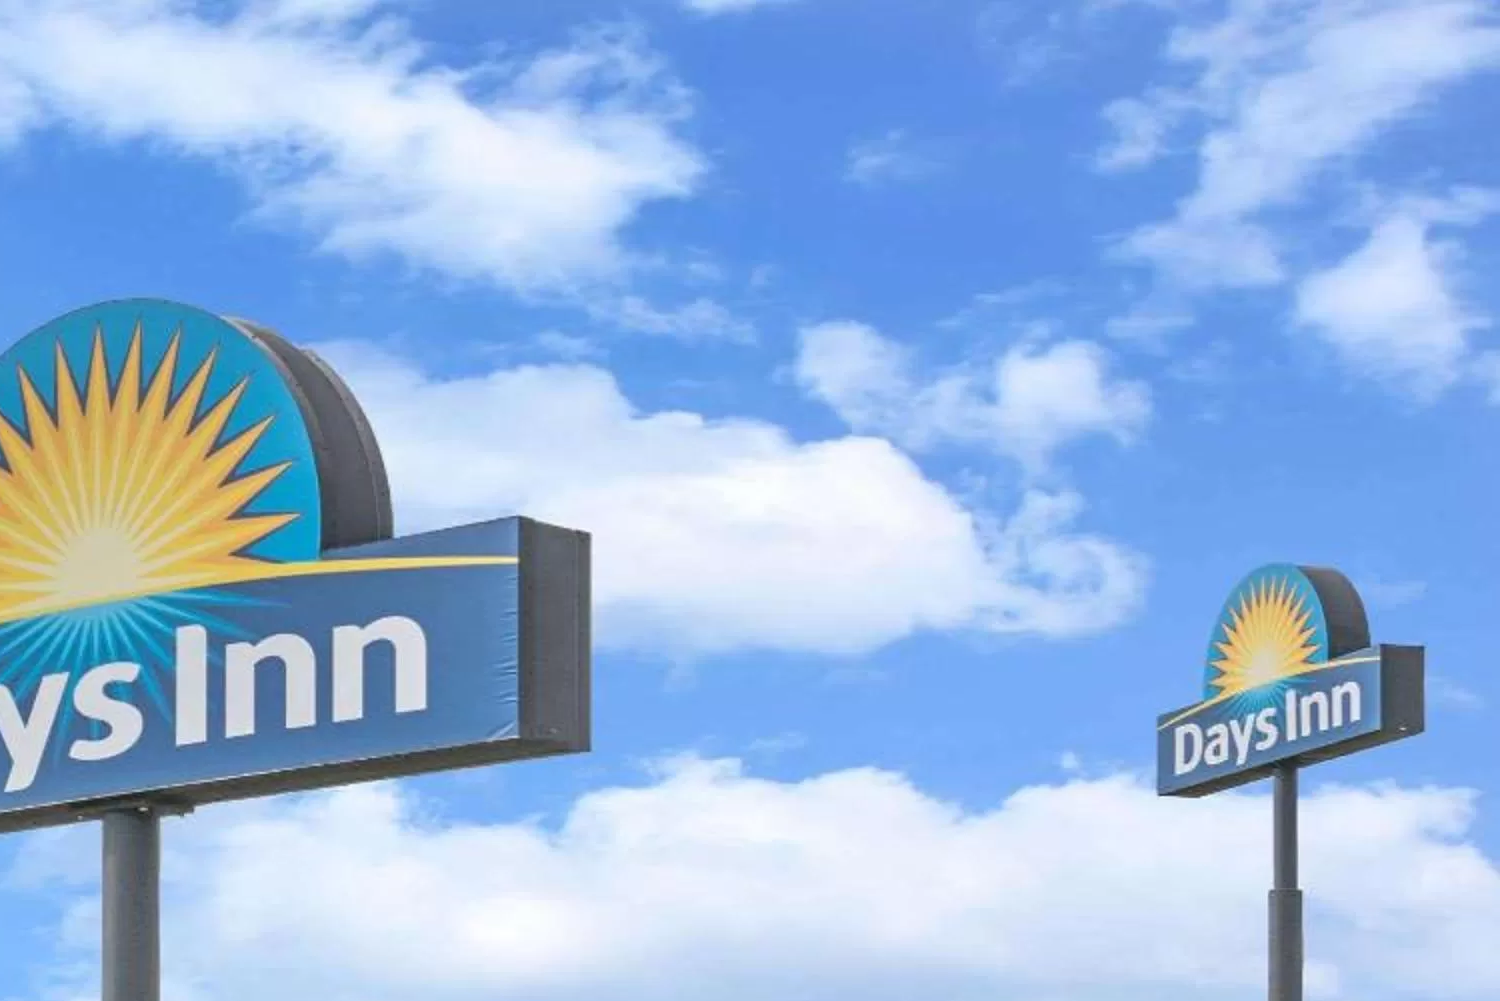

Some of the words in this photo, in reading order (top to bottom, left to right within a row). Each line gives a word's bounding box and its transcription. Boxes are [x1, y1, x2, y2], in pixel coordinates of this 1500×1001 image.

[175, 615, 427, 746] Inn
[1174, 706, 1279, 775] Days
[1285, 680, 1362, 742] Inn
